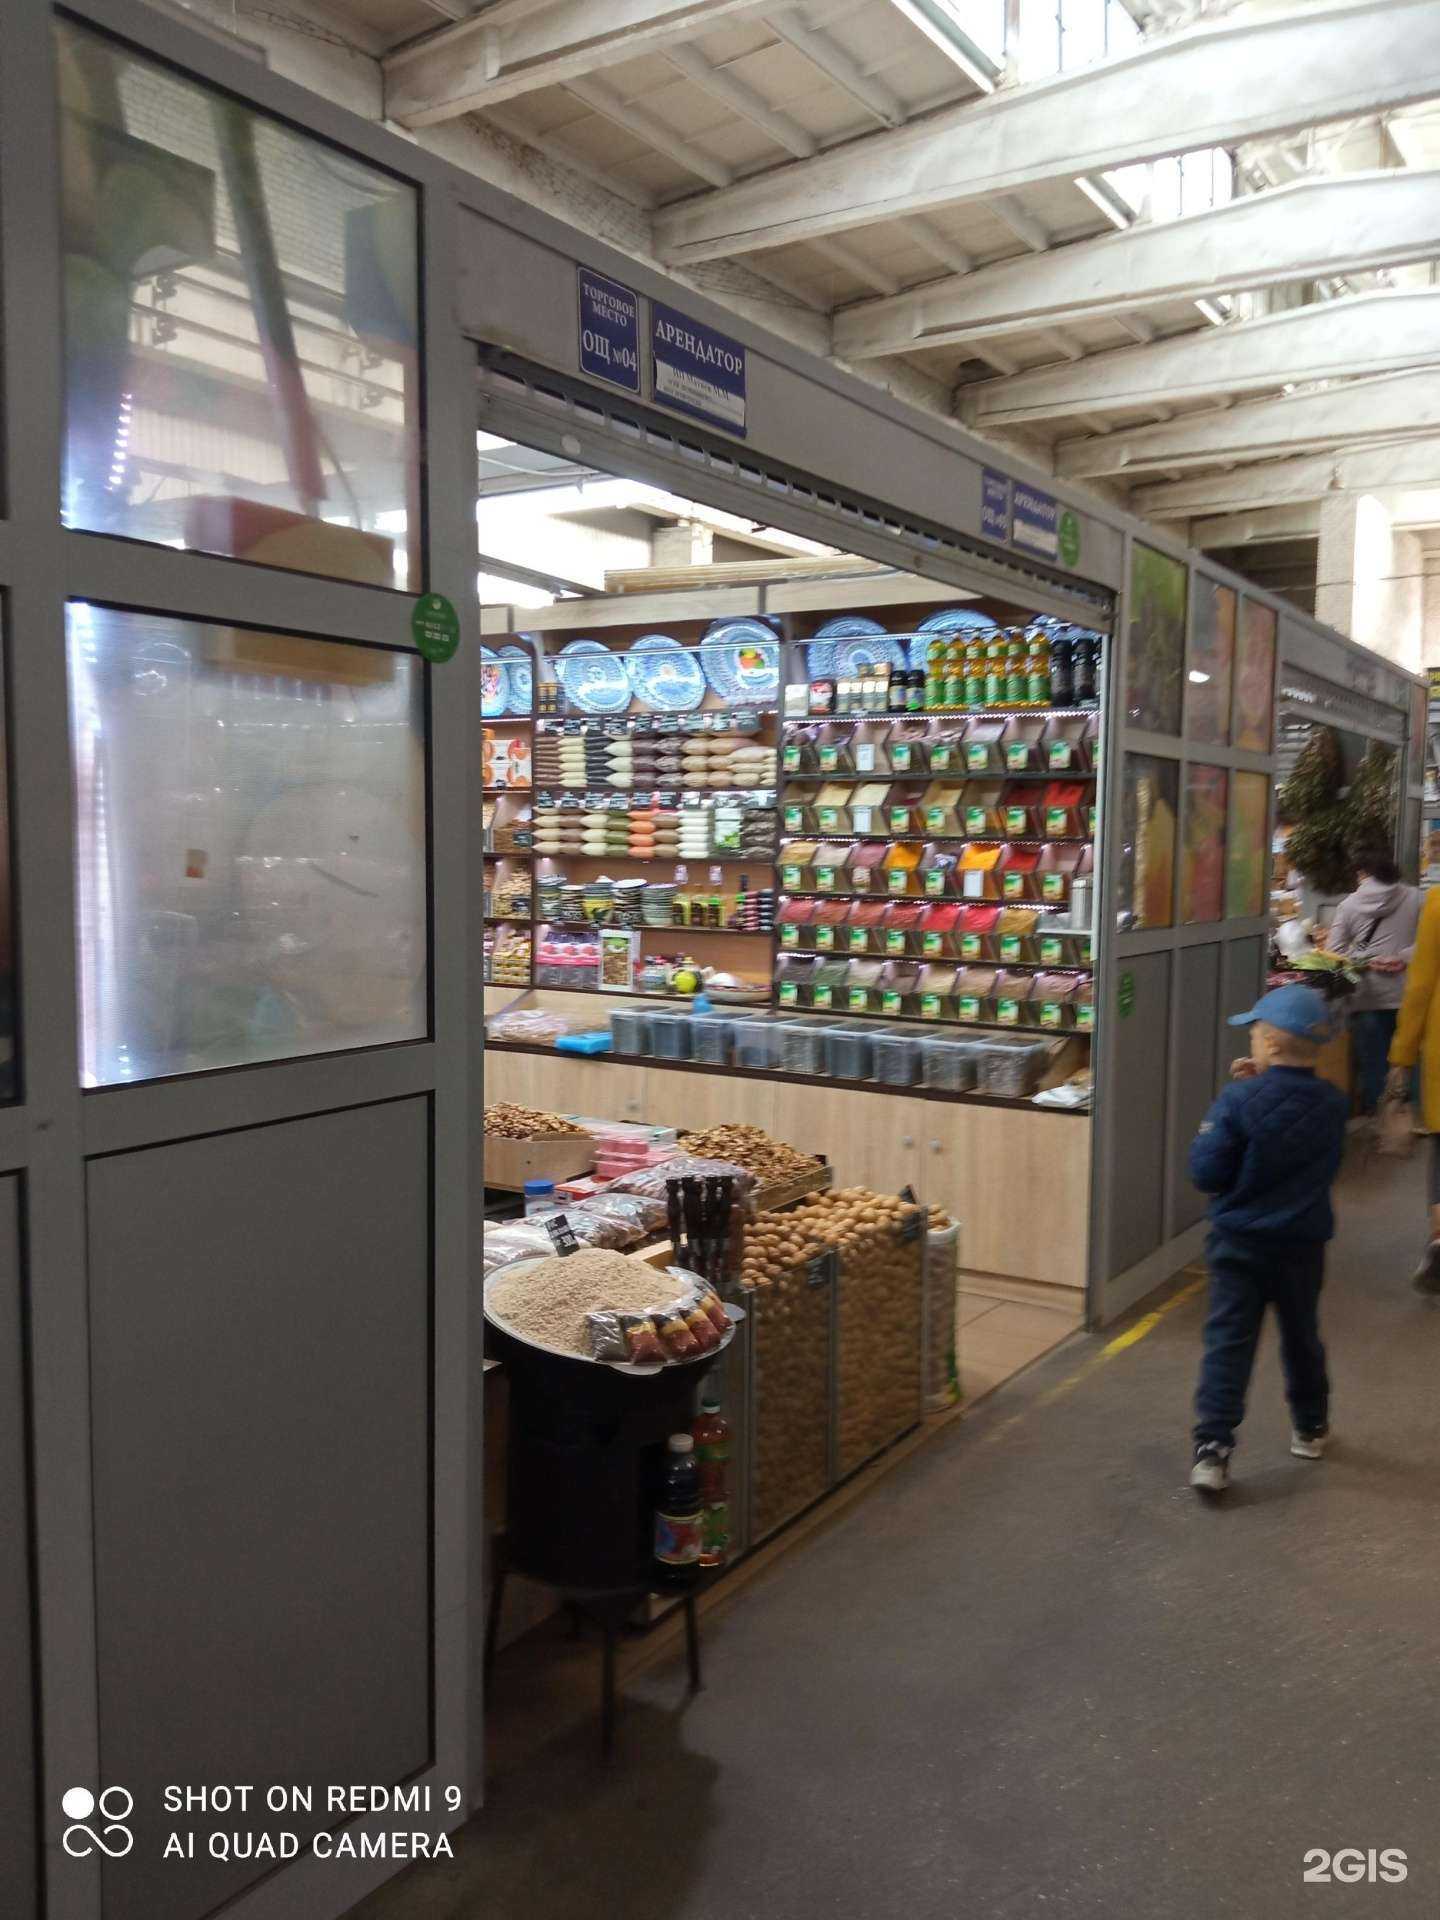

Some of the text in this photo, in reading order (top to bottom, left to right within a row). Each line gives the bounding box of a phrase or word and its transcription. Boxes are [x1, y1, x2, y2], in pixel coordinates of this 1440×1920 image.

[583, 283, 635, 318] ТОРГОВОЕ
[592, 301, 627, 327] МЕСТО
[583, 329, 611, 365] ОЩ
[655, 319, 743, 376] АРЕНДАТОР
